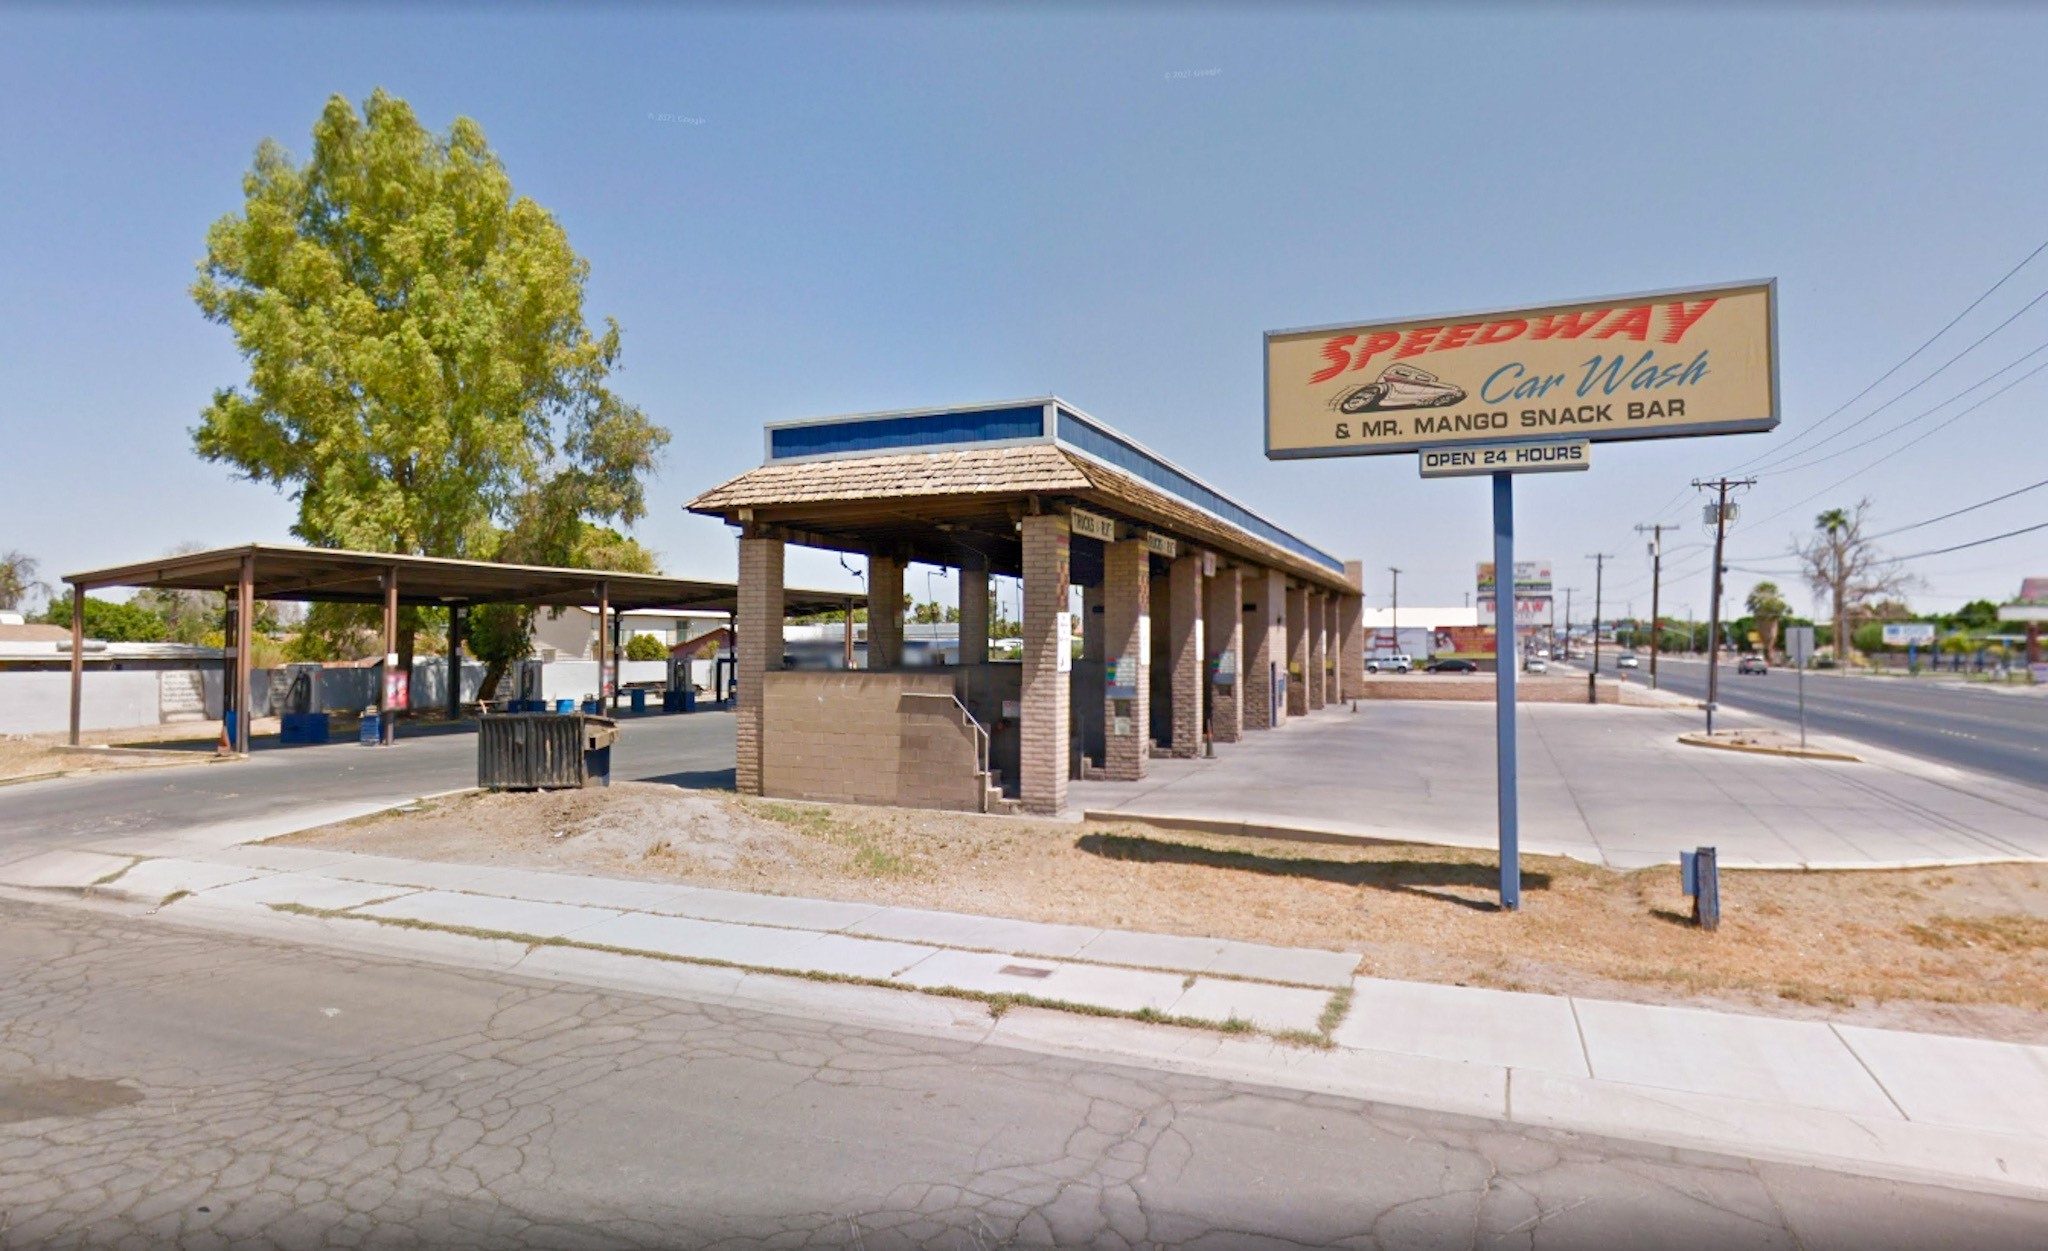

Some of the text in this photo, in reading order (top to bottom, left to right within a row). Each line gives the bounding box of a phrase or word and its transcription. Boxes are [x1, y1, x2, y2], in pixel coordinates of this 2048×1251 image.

[1307, 299, 1719, 385] SPEEDWAY
[1480, 350, 1711, 404] Car Wash
[1335, 399, 1685, 439] & MR. MANGO SNACK BAR
[1426, 446, 1582, 467] OPEN 24 HOURS
